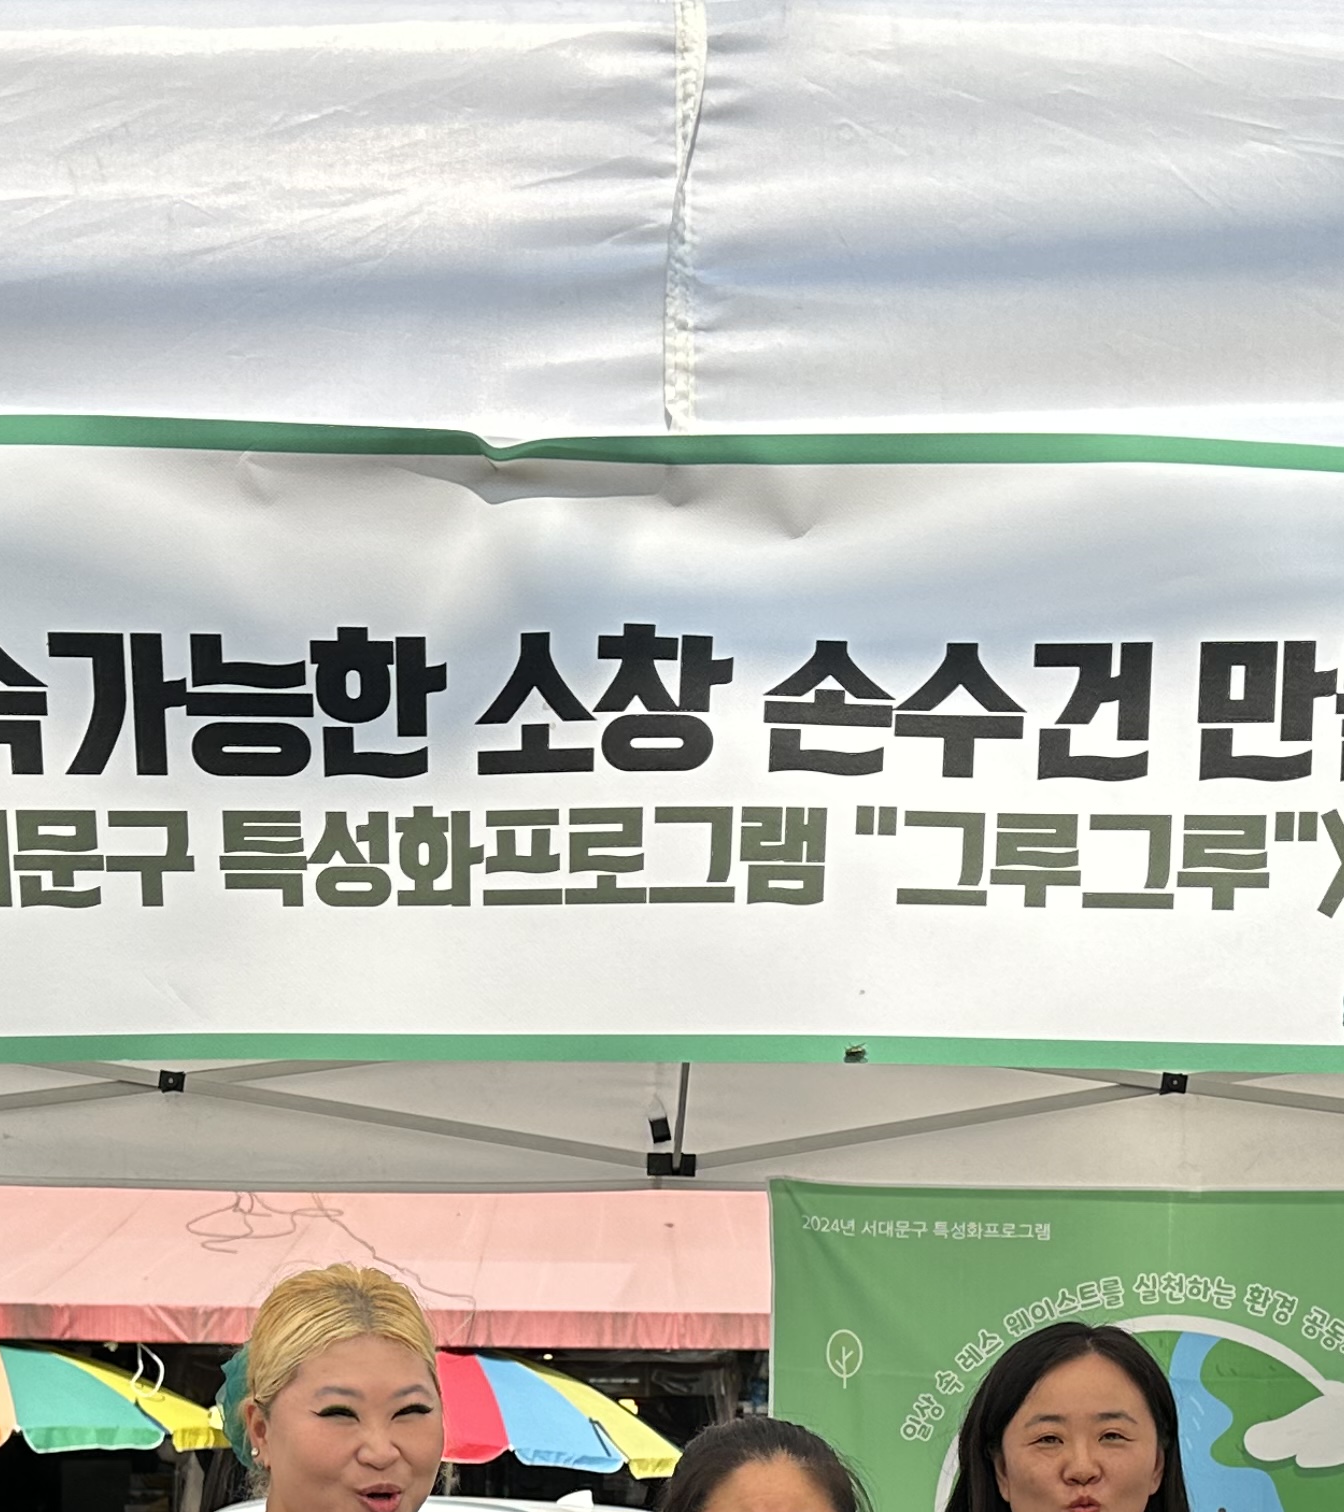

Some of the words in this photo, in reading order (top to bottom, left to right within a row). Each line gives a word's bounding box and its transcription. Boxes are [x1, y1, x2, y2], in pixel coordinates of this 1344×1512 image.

[475, 623, 734, 776] 소창
[763, 639, 1154, 783] 손수건
[219, 805, 828, 907] 특성화프로그램
[801, 1214, 856, 1237] 2024년
[860, 1219, 928, 1239] 서대문구
[932, 1220, 1051, 1241] 특성화프로그램
[900, 1393, 945, 1442] 일상
[934, 1369, 965, 1395] 속
[955, 1328, 1005, 1372] 레스
[1002, 1276, 1124, 1337] 웨이스트를
[1133, 1271, 1236, 1309] 실천하는
[1245, 1283, 1299, 1325] 환경
